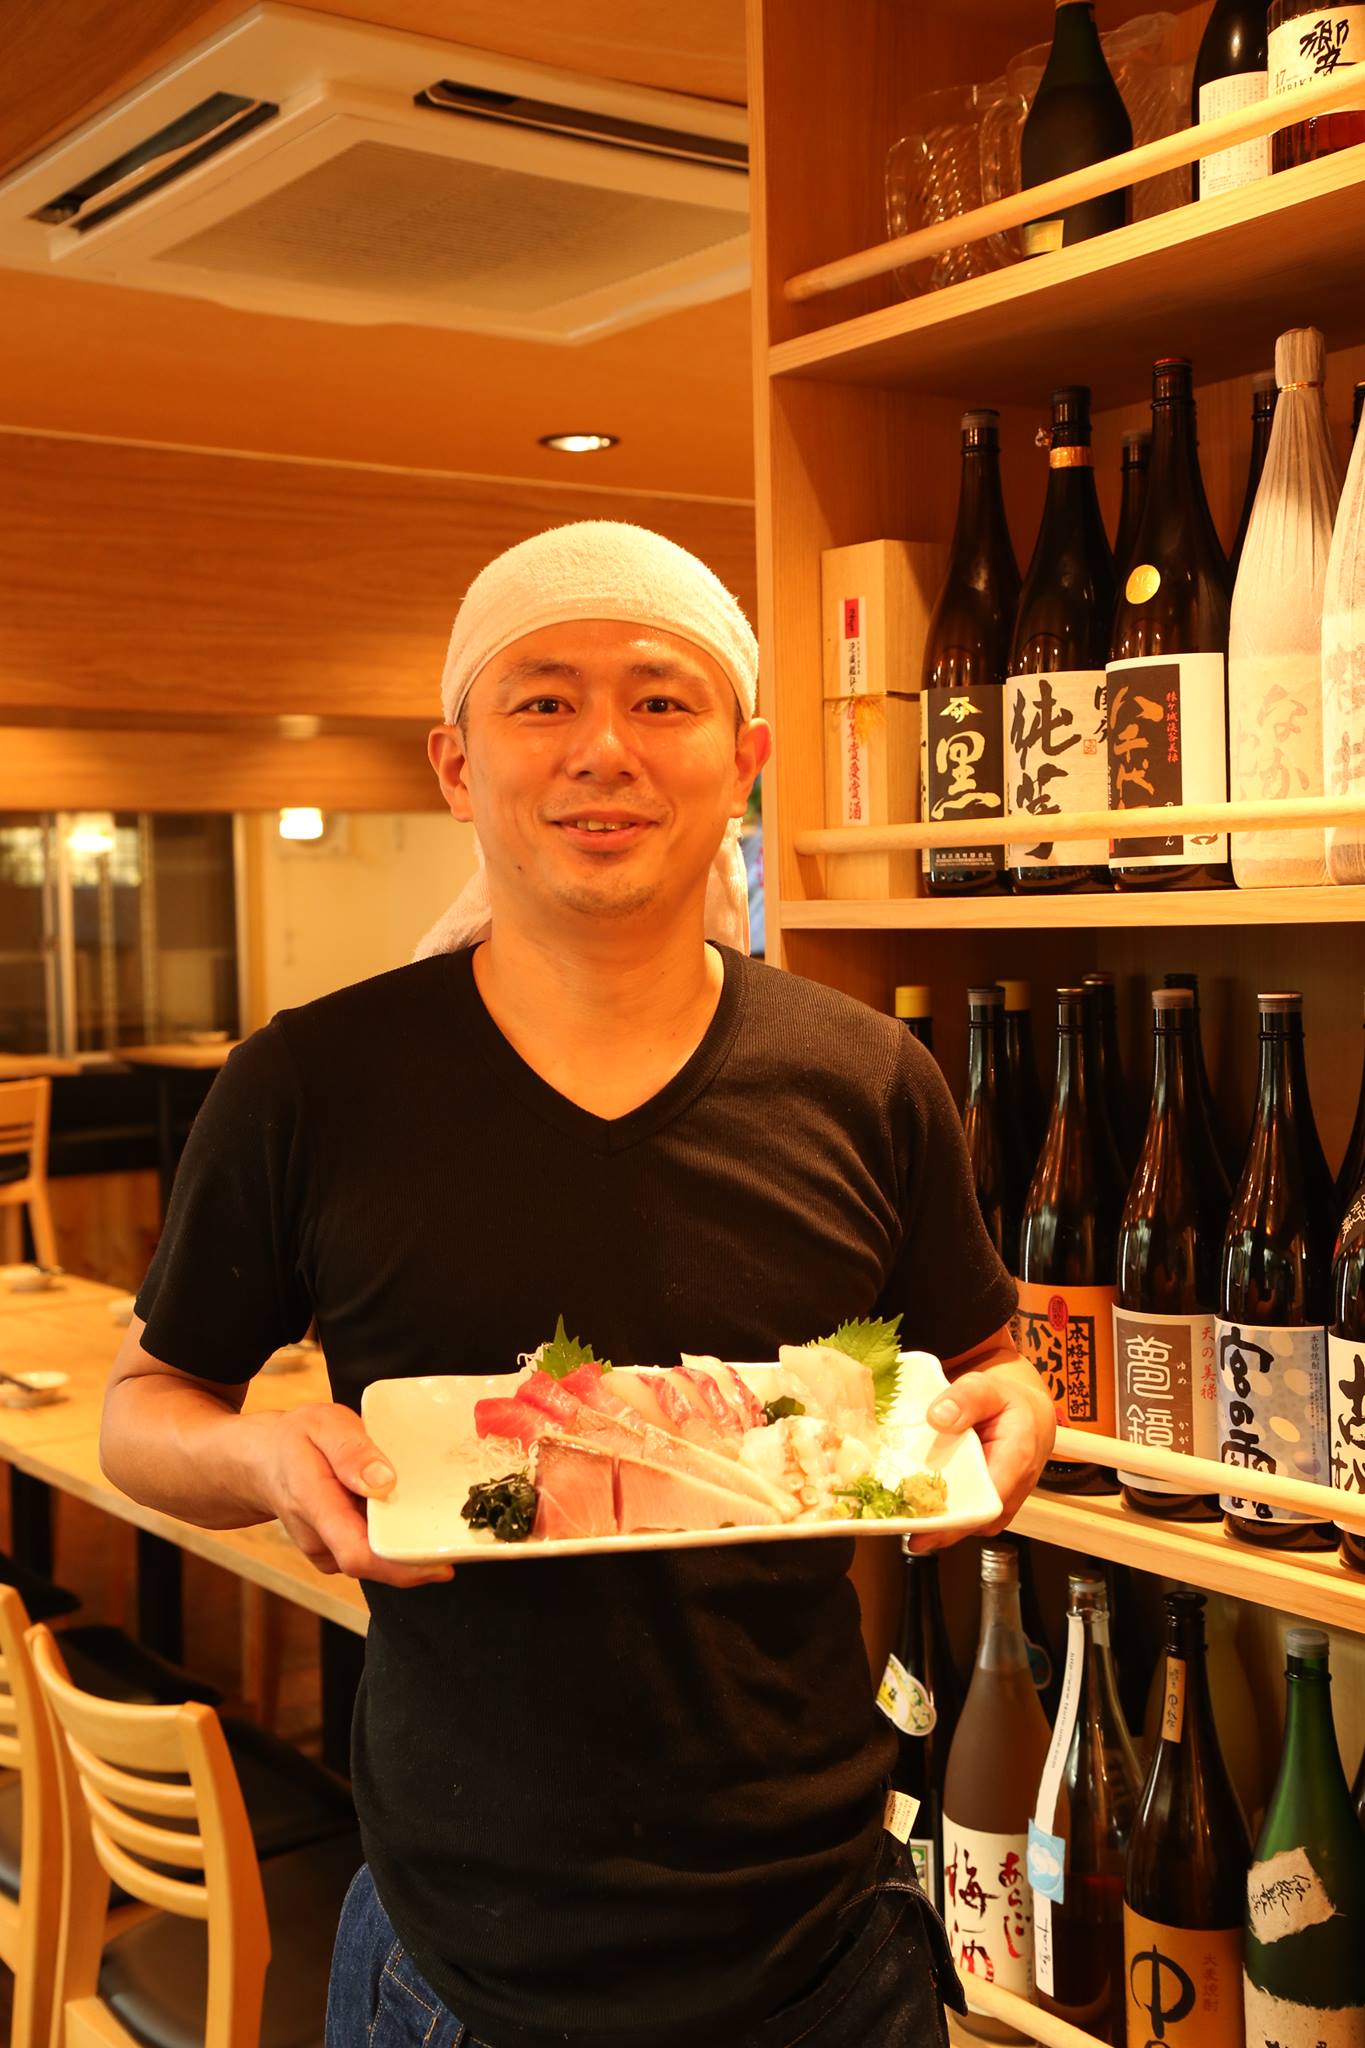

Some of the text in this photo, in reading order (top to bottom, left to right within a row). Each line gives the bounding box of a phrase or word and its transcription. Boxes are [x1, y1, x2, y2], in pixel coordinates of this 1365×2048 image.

[931, 731, 1001, 820] 黒
[1110, 686, 1164, 811] 八千代
[1068, 1322, 1090, 1416] 本格芋焼酎
[1200, 1326, 1217, 1400] 天の美禄
